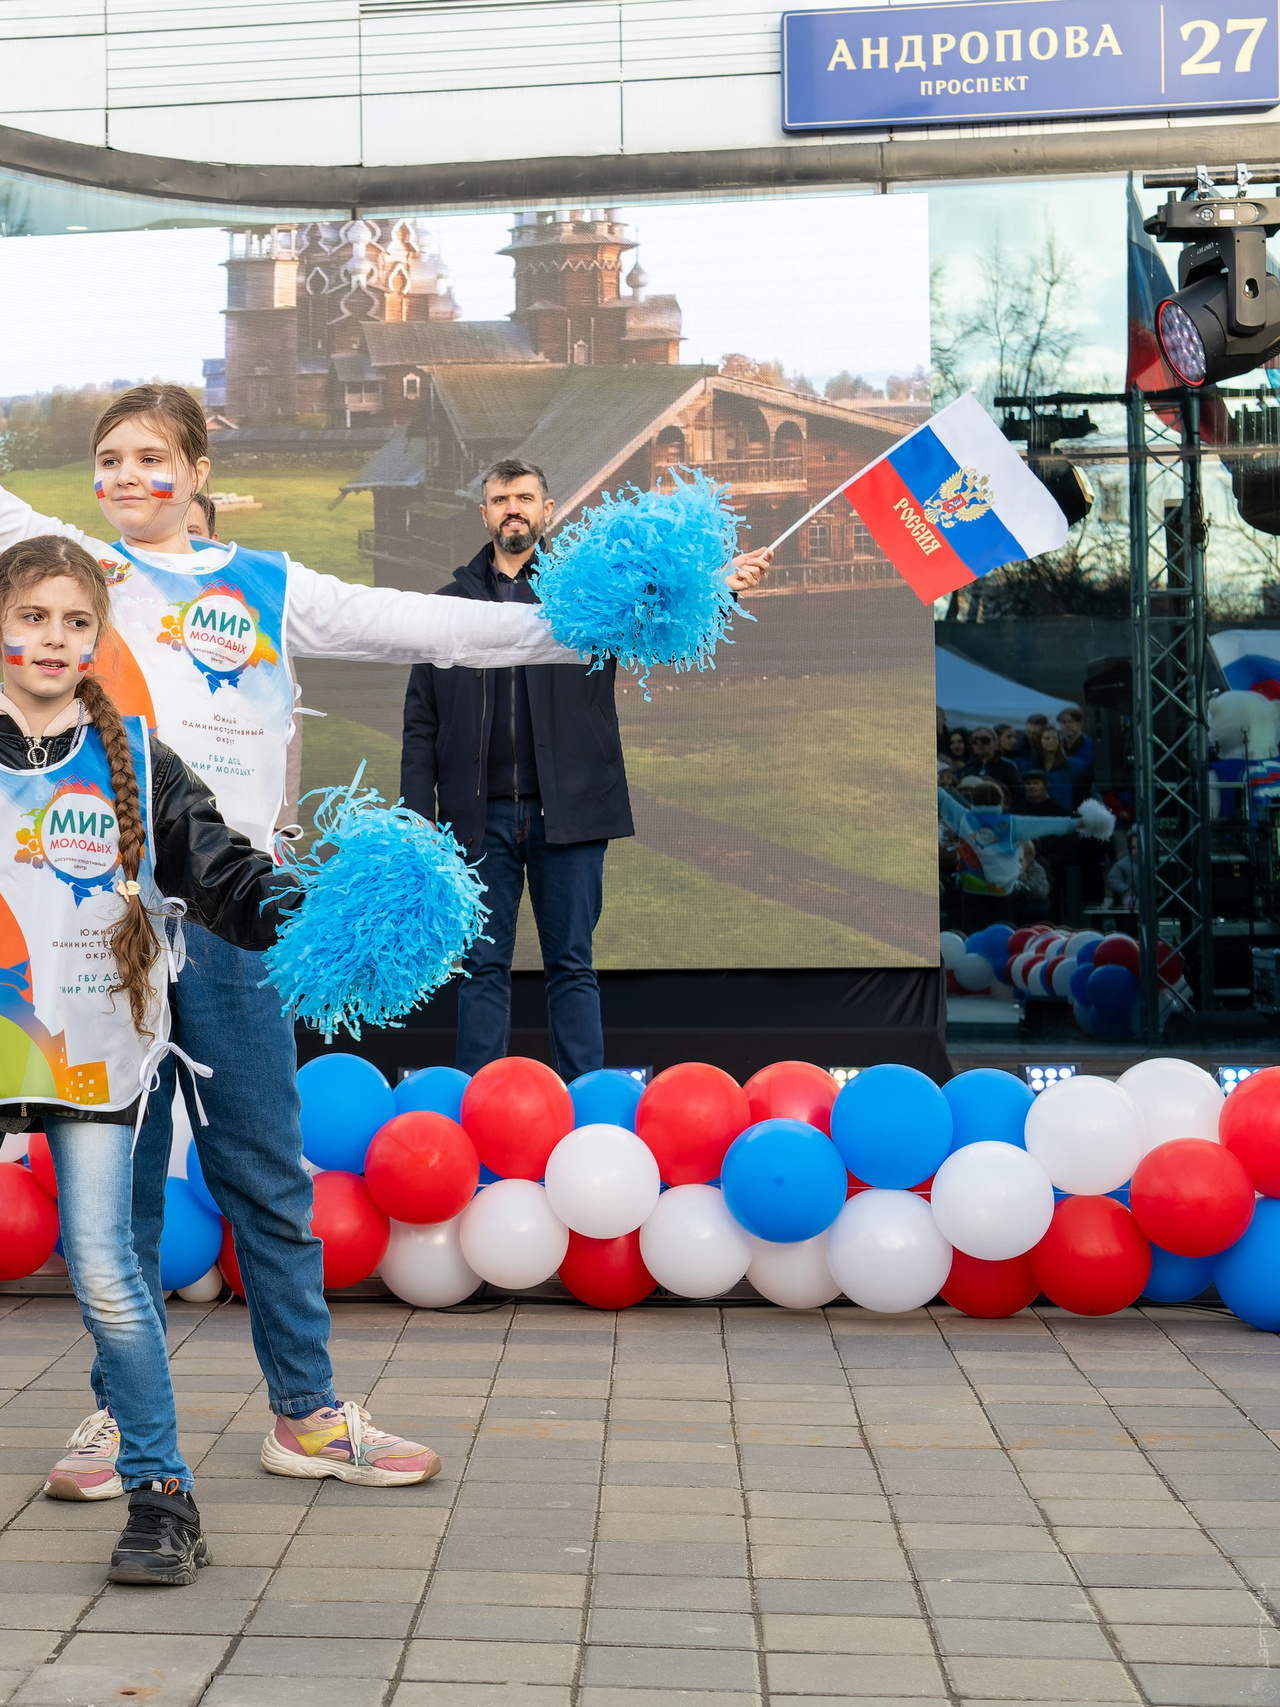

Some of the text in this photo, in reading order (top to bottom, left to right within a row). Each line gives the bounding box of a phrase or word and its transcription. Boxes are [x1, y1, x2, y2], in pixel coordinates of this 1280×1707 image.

[827, 23, 1123, 73] АНДРОПОВА
[1180, 17, 1268, 76] 27
[920, 75, 1029, 96] ПРОСПЕКТ
[892, 497, 942, 556] РОССИЯ
[191, 605, 251, 639] МИР
[189, 630, 247, 655] МОЛОДЫХ
[181, 719, 264, 737] административный
[213, 714, 237, 725] Южный
[208, 754, 242, 766] ГБУ ДСЦ
[49, 808, 115, 839] МИР
[50, 838, 112, 855] МОЛОДЫХ
[78, 971, 122, 982] ГБУ ДС
